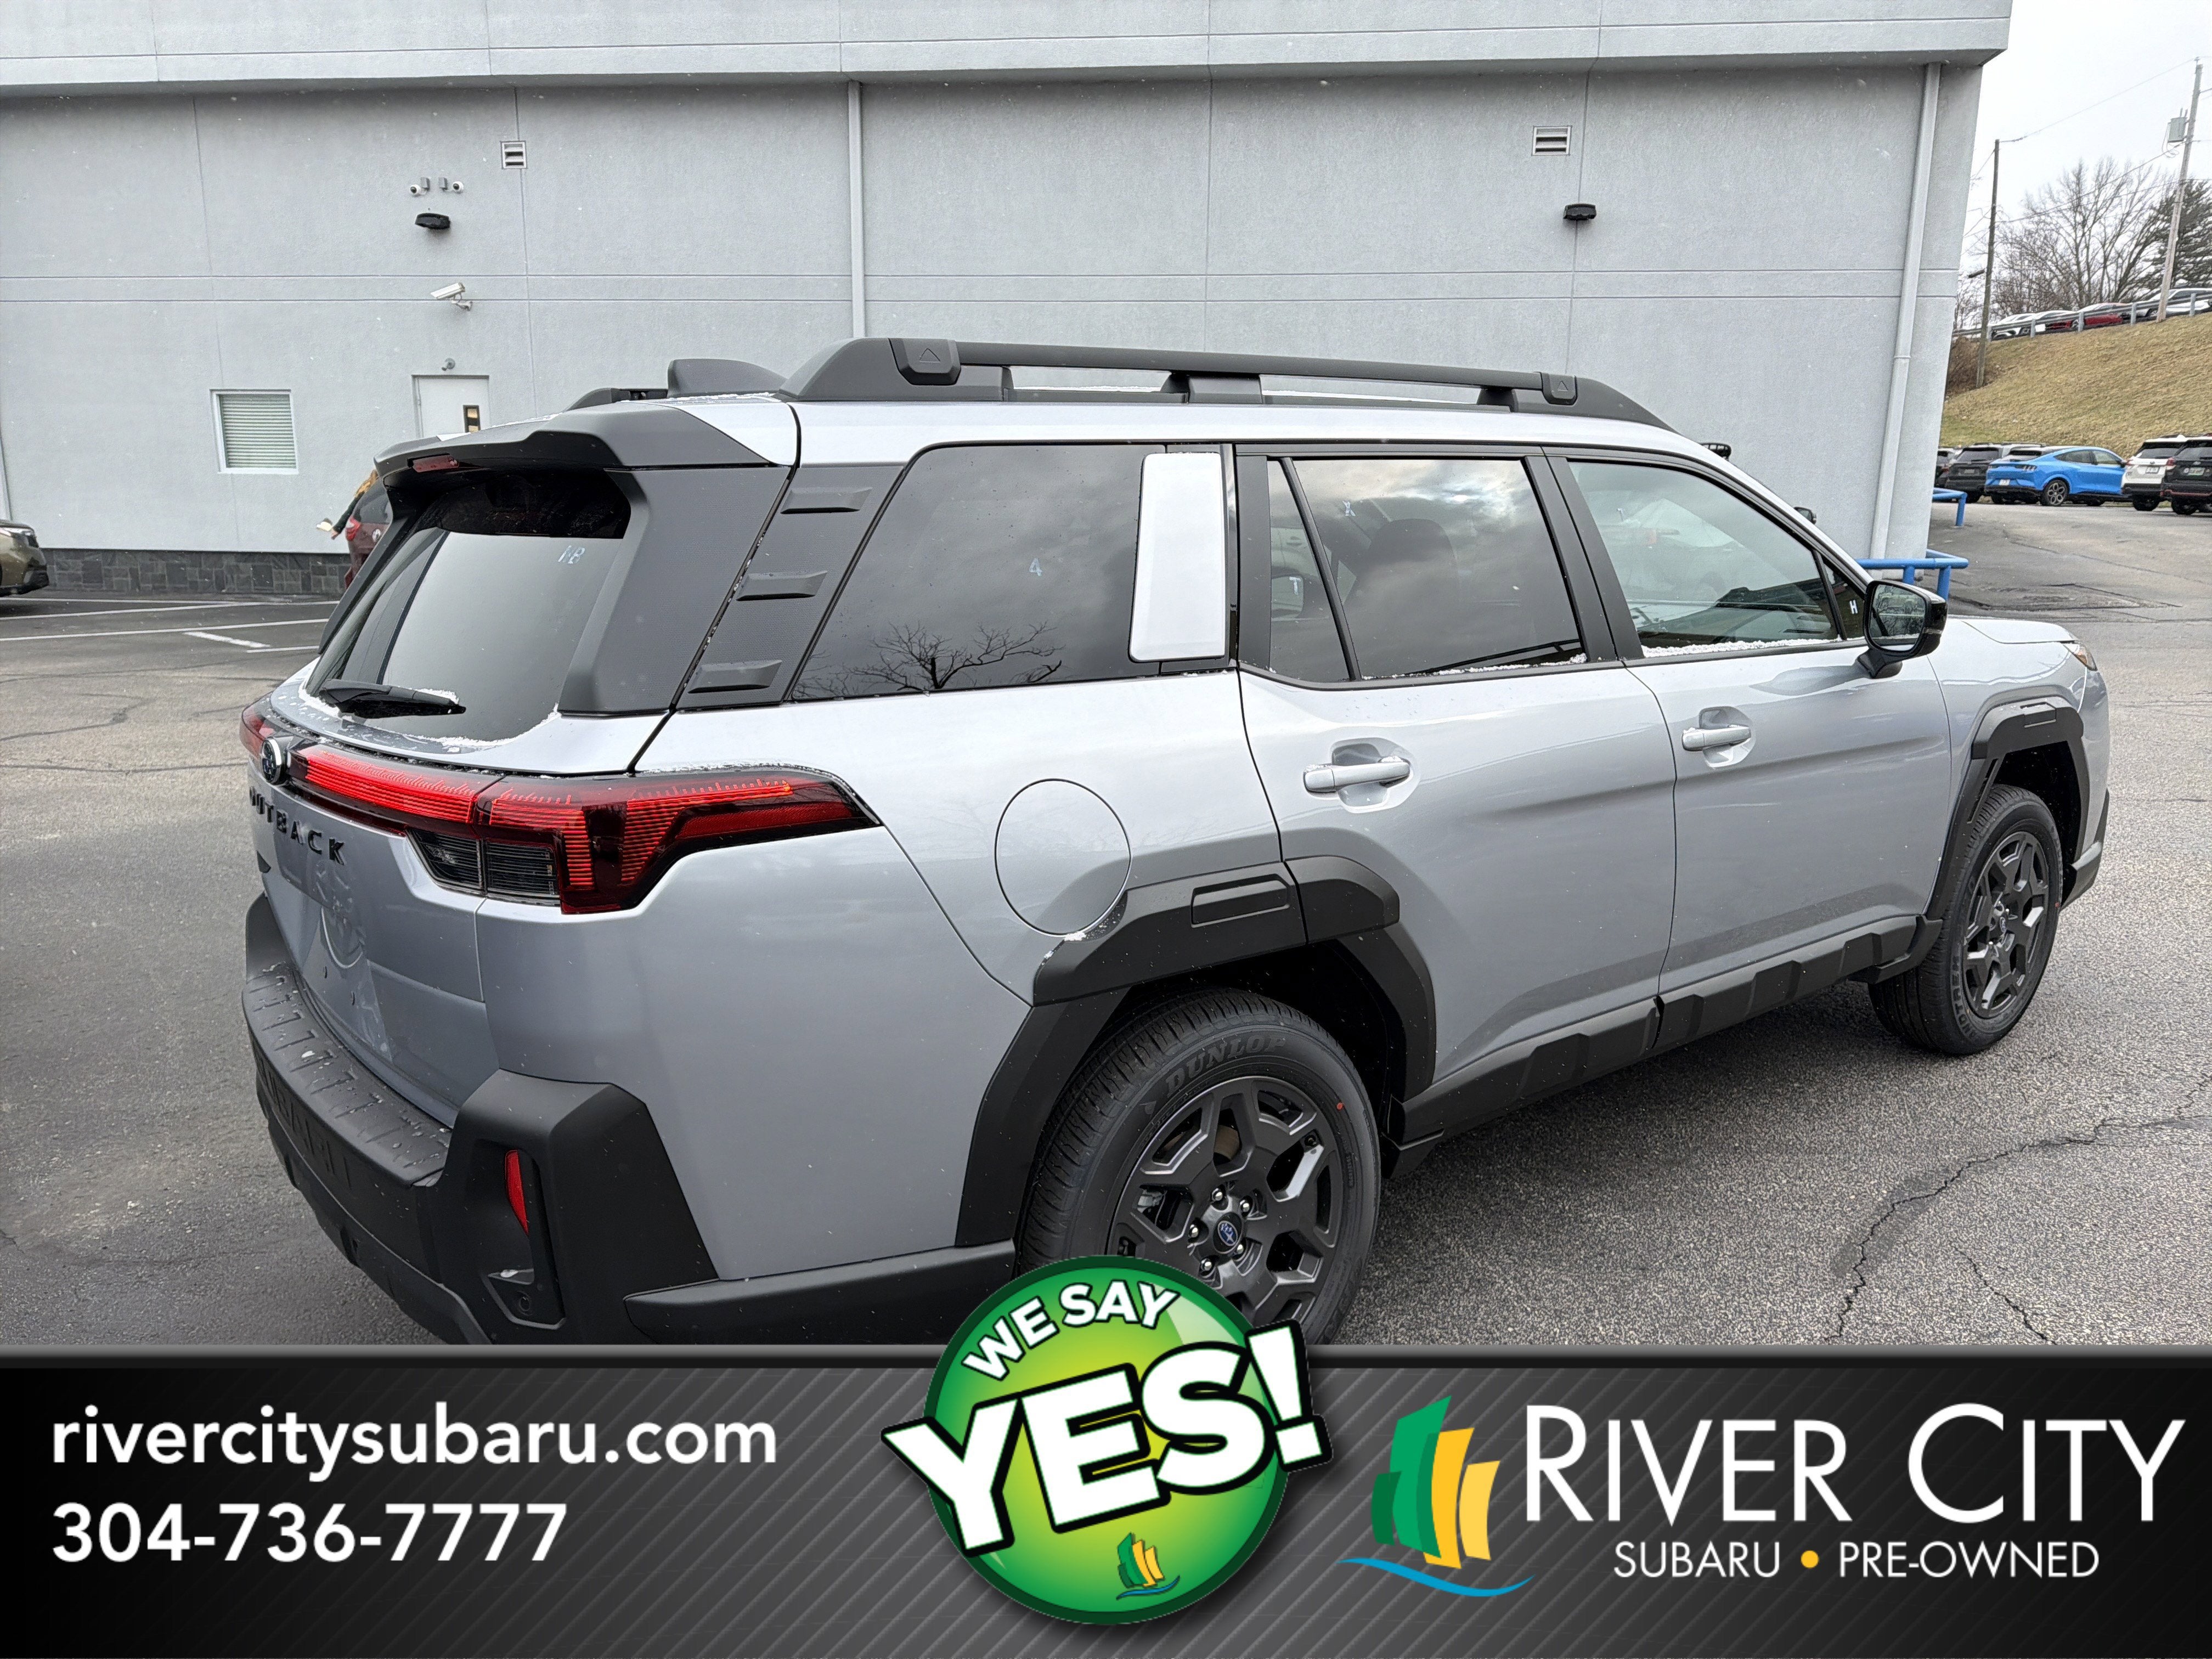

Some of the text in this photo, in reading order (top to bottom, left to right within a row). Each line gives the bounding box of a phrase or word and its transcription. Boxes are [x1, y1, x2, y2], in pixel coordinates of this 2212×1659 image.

[1029, 557, 1043, 577] 4
[1288, 576, 1301, 595] T
[1849, 599, 1858, 614] H
[249, 786, 346, 866] OUTBACK
[1166, 1034, 1286, 1098] DUNLOP
